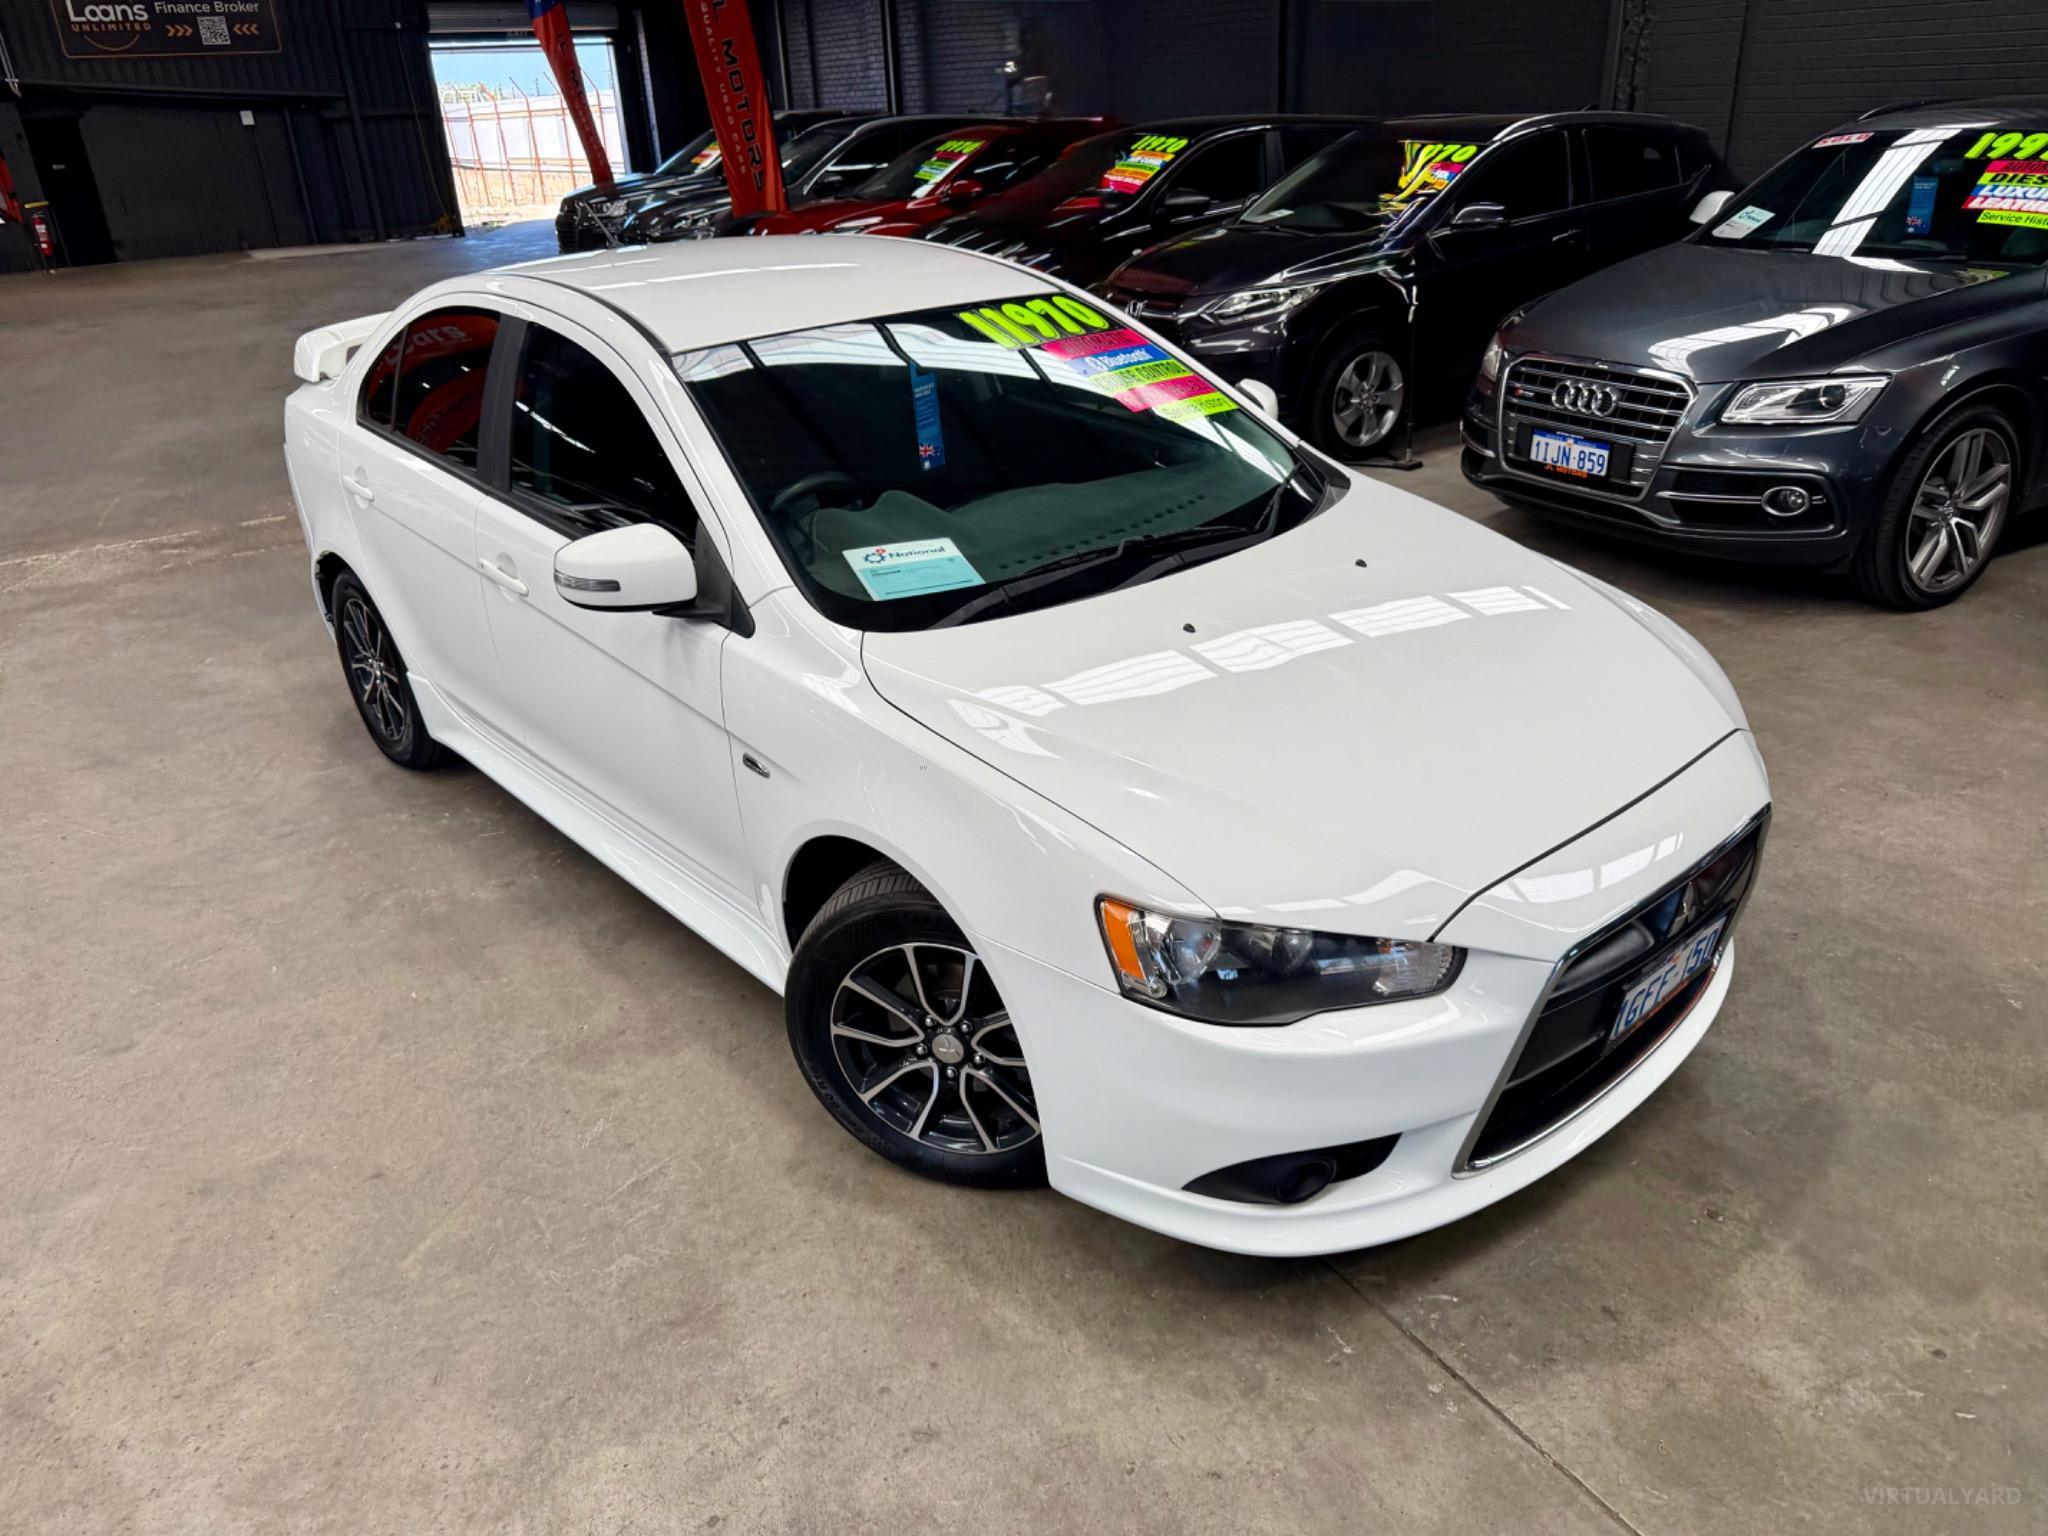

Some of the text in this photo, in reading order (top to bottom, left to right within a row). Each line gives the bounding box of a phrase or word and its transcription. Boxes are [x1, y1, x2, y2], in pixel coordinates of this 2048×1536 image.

[65, 0, 149, 22] Loans
[155, 0, 259, 13] Finance Broker
[71, 22, 152, 32] UNLIMITED
[701, 1, 747, 175] QUALITY USED CARS
[1131, 135, 1188, 153] 11970
[1964, 132, 2048, 160] 199
[1981, 212, 2023, 222] Service
[958, 296, 1109, 350] 11970
[888, 546, 946, 559] National
